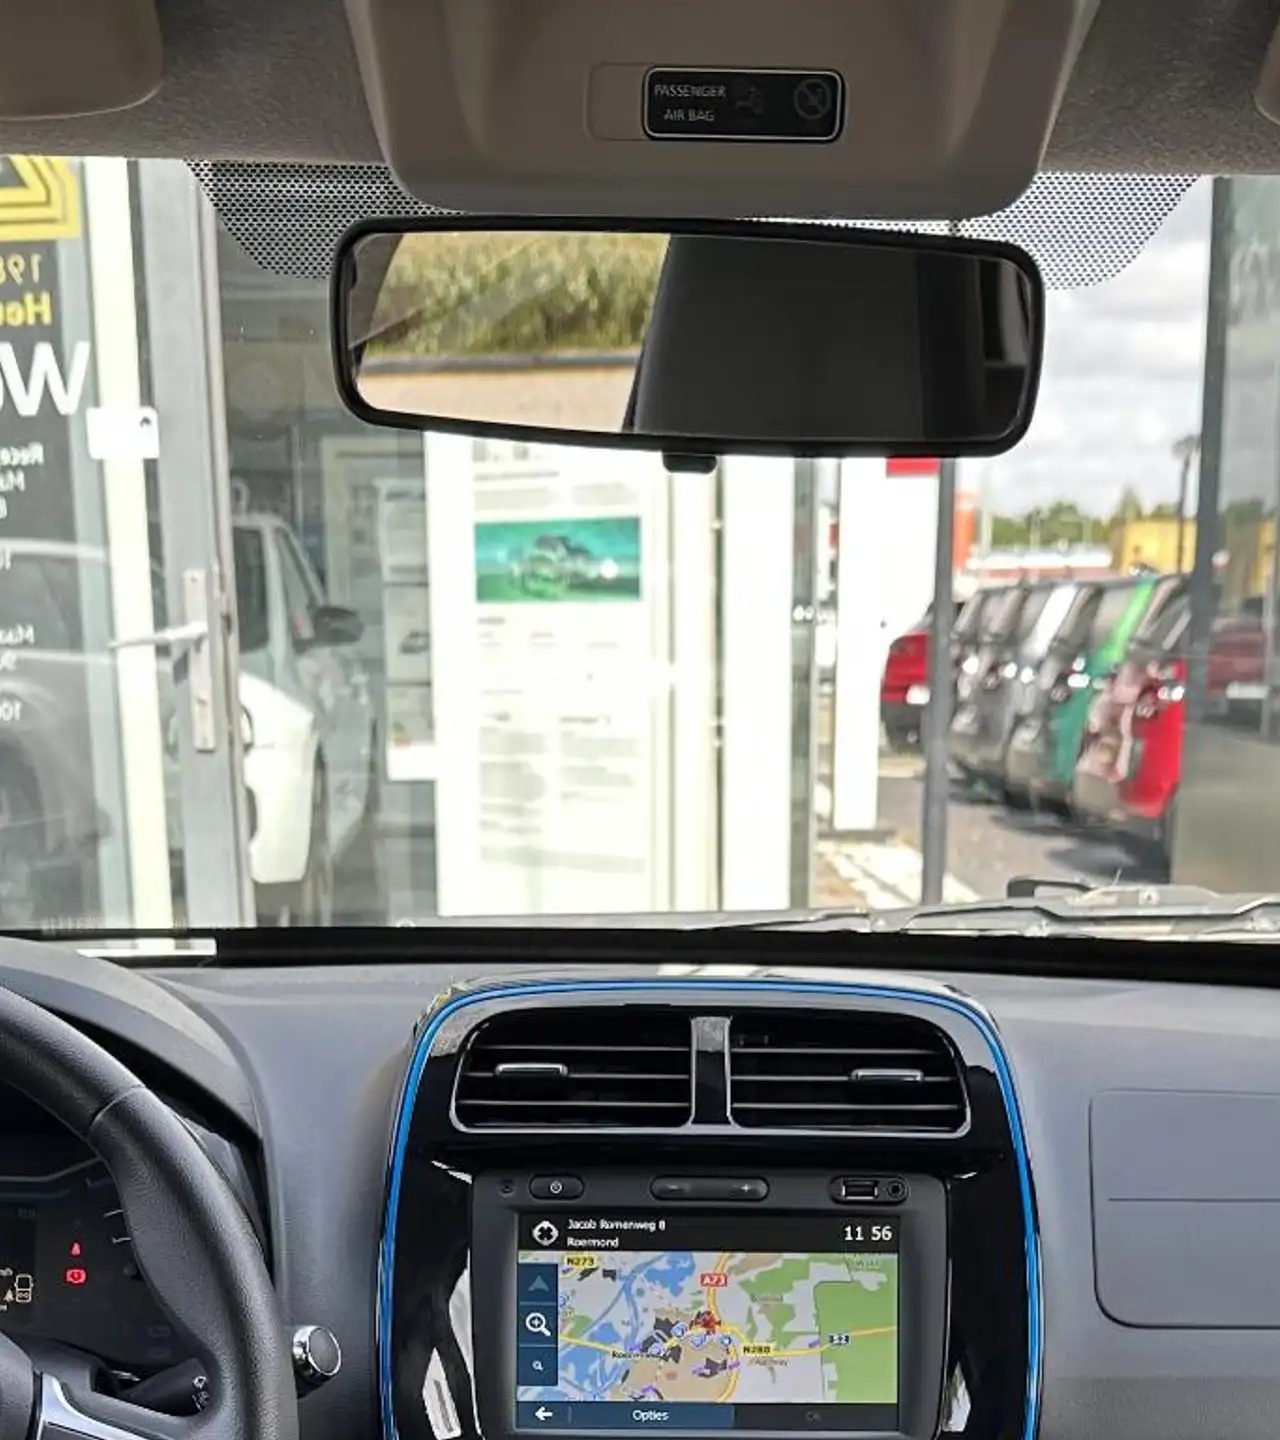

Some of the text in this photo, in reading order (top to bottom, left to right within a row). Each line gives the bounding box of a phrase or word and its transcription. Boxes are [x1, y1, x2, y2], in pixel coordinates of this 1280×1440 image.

[654, 84, 727, 98] PASSENGER
[664, 108, 715, 122] AIR BAG
[871, 1225, 893, 1241] 56
[567, 1237, 619, 1249] Roermond
[632, 1410, 670, 1424] Opties
